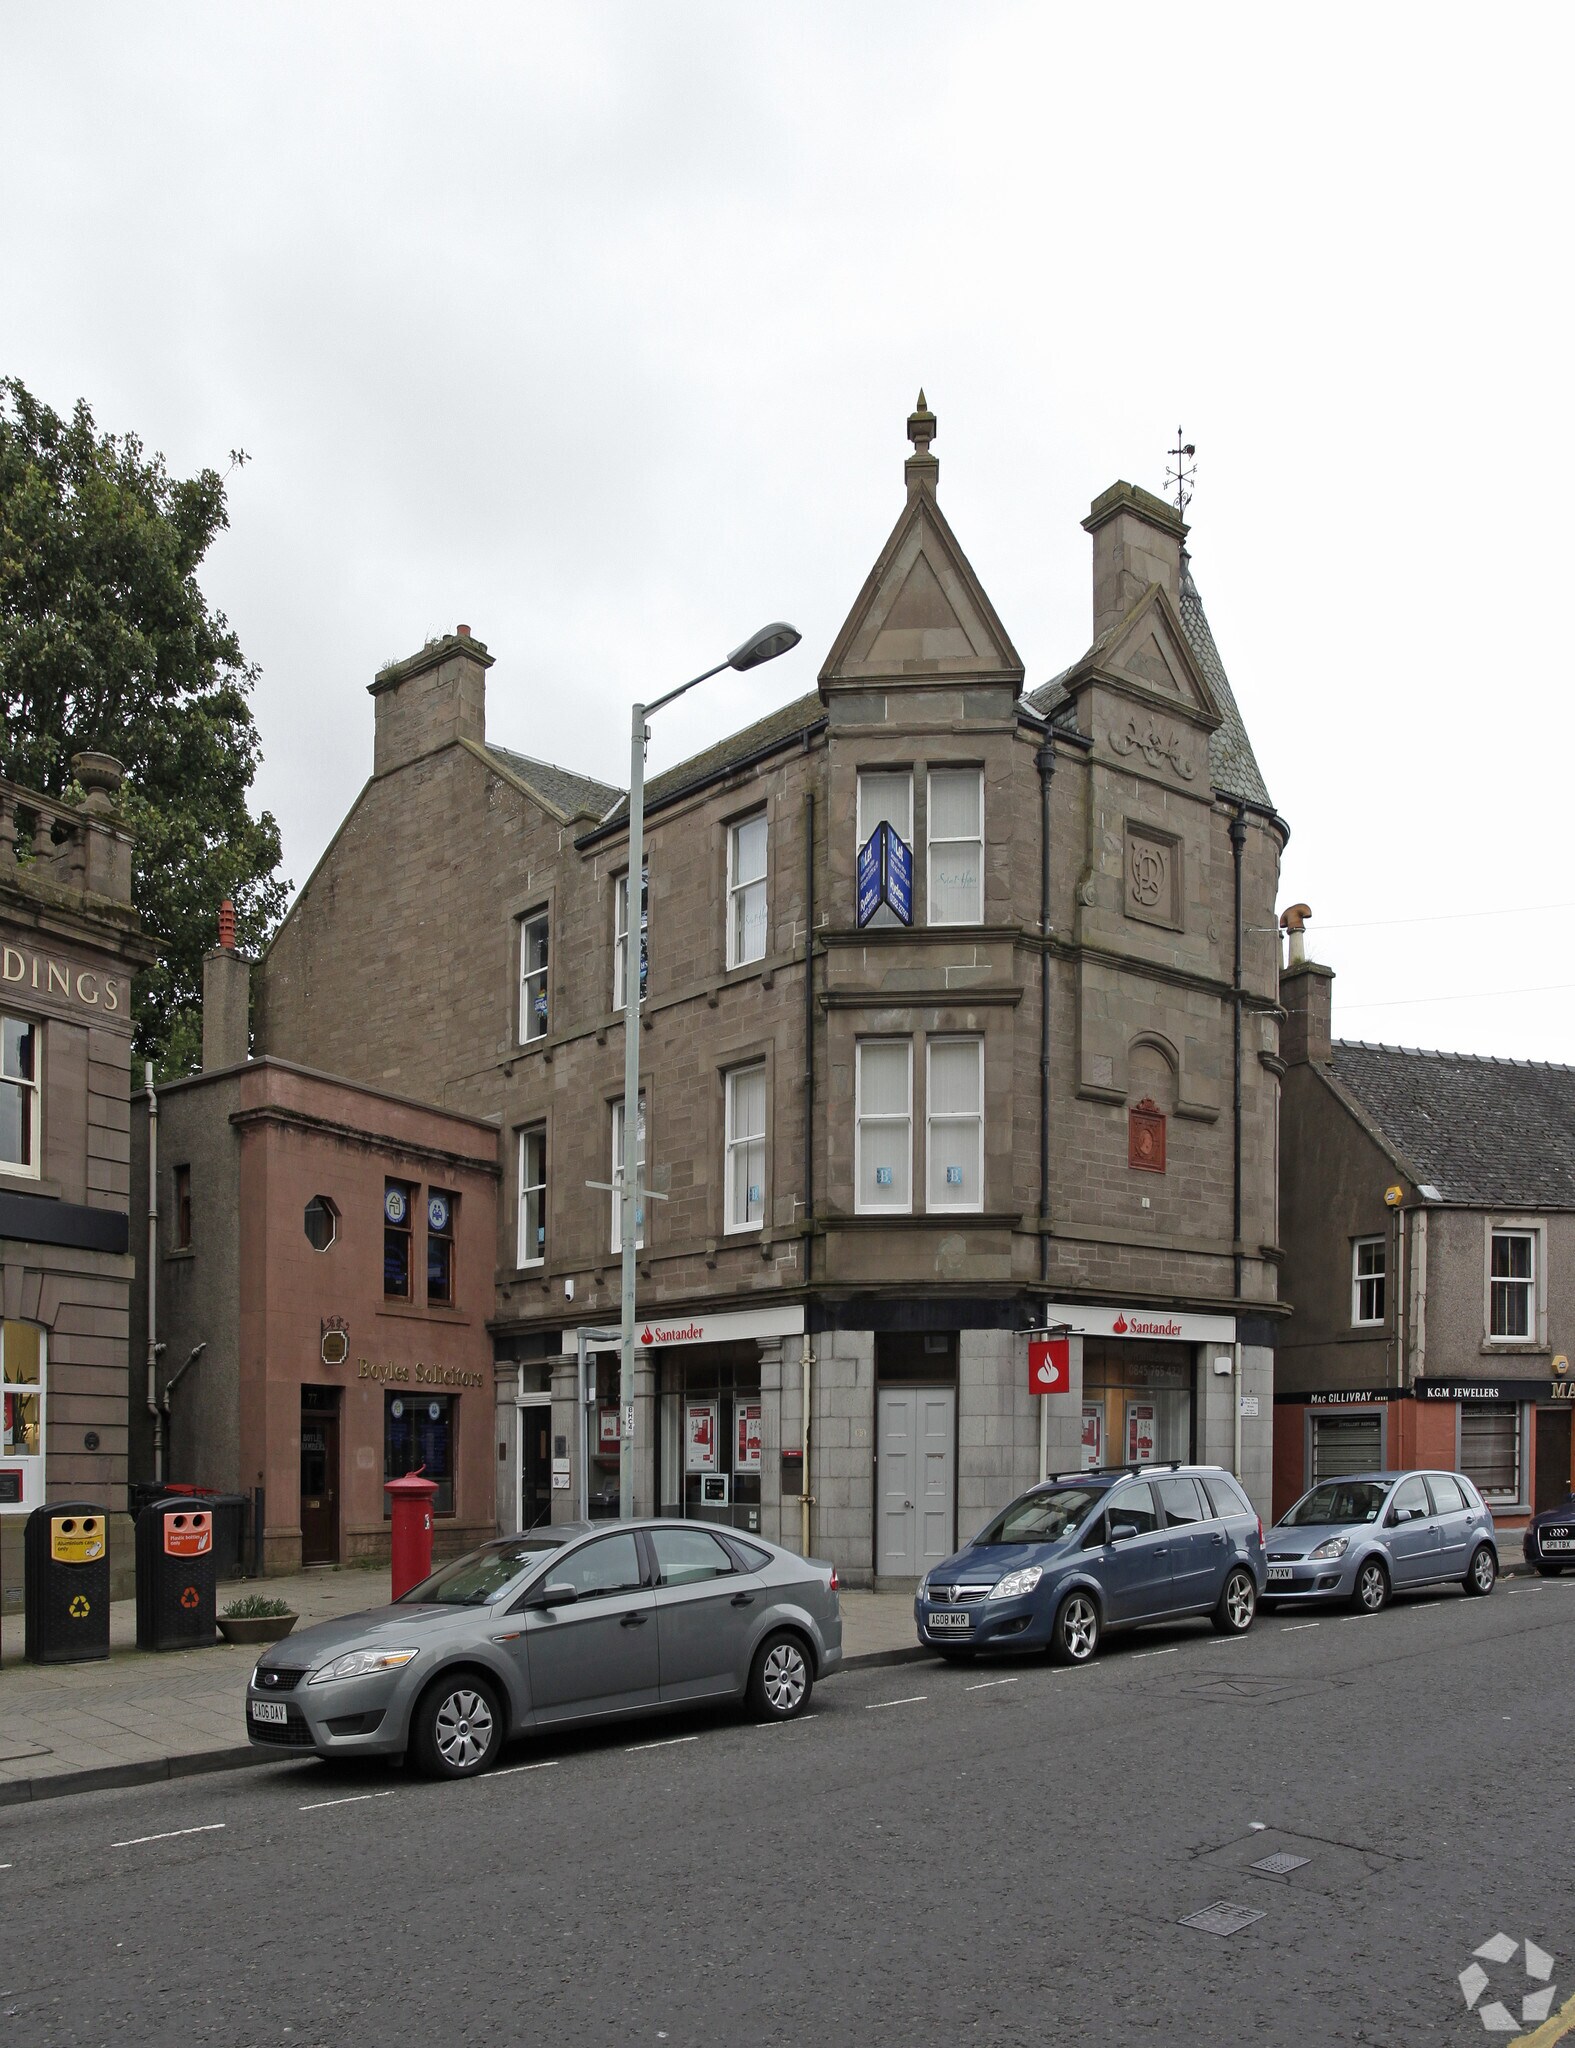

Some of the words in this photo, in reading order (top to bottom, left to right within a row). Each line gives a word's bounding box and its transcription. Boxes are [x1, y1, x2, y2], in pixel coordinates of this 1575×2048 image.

[655, 1323, 703, 1342] Santander
[1130, 1318, 1182, 1335] Santander
[357, 1358, 409, 1386] Boyles
[415, 1362, 483, 1387] Solicitors
[308, 1393, 317, 1405] 77
[1328, 1392, 1372, 1403] GILLIVRAY
[1453, 1388, 1499, 1398] JEWELLERS
